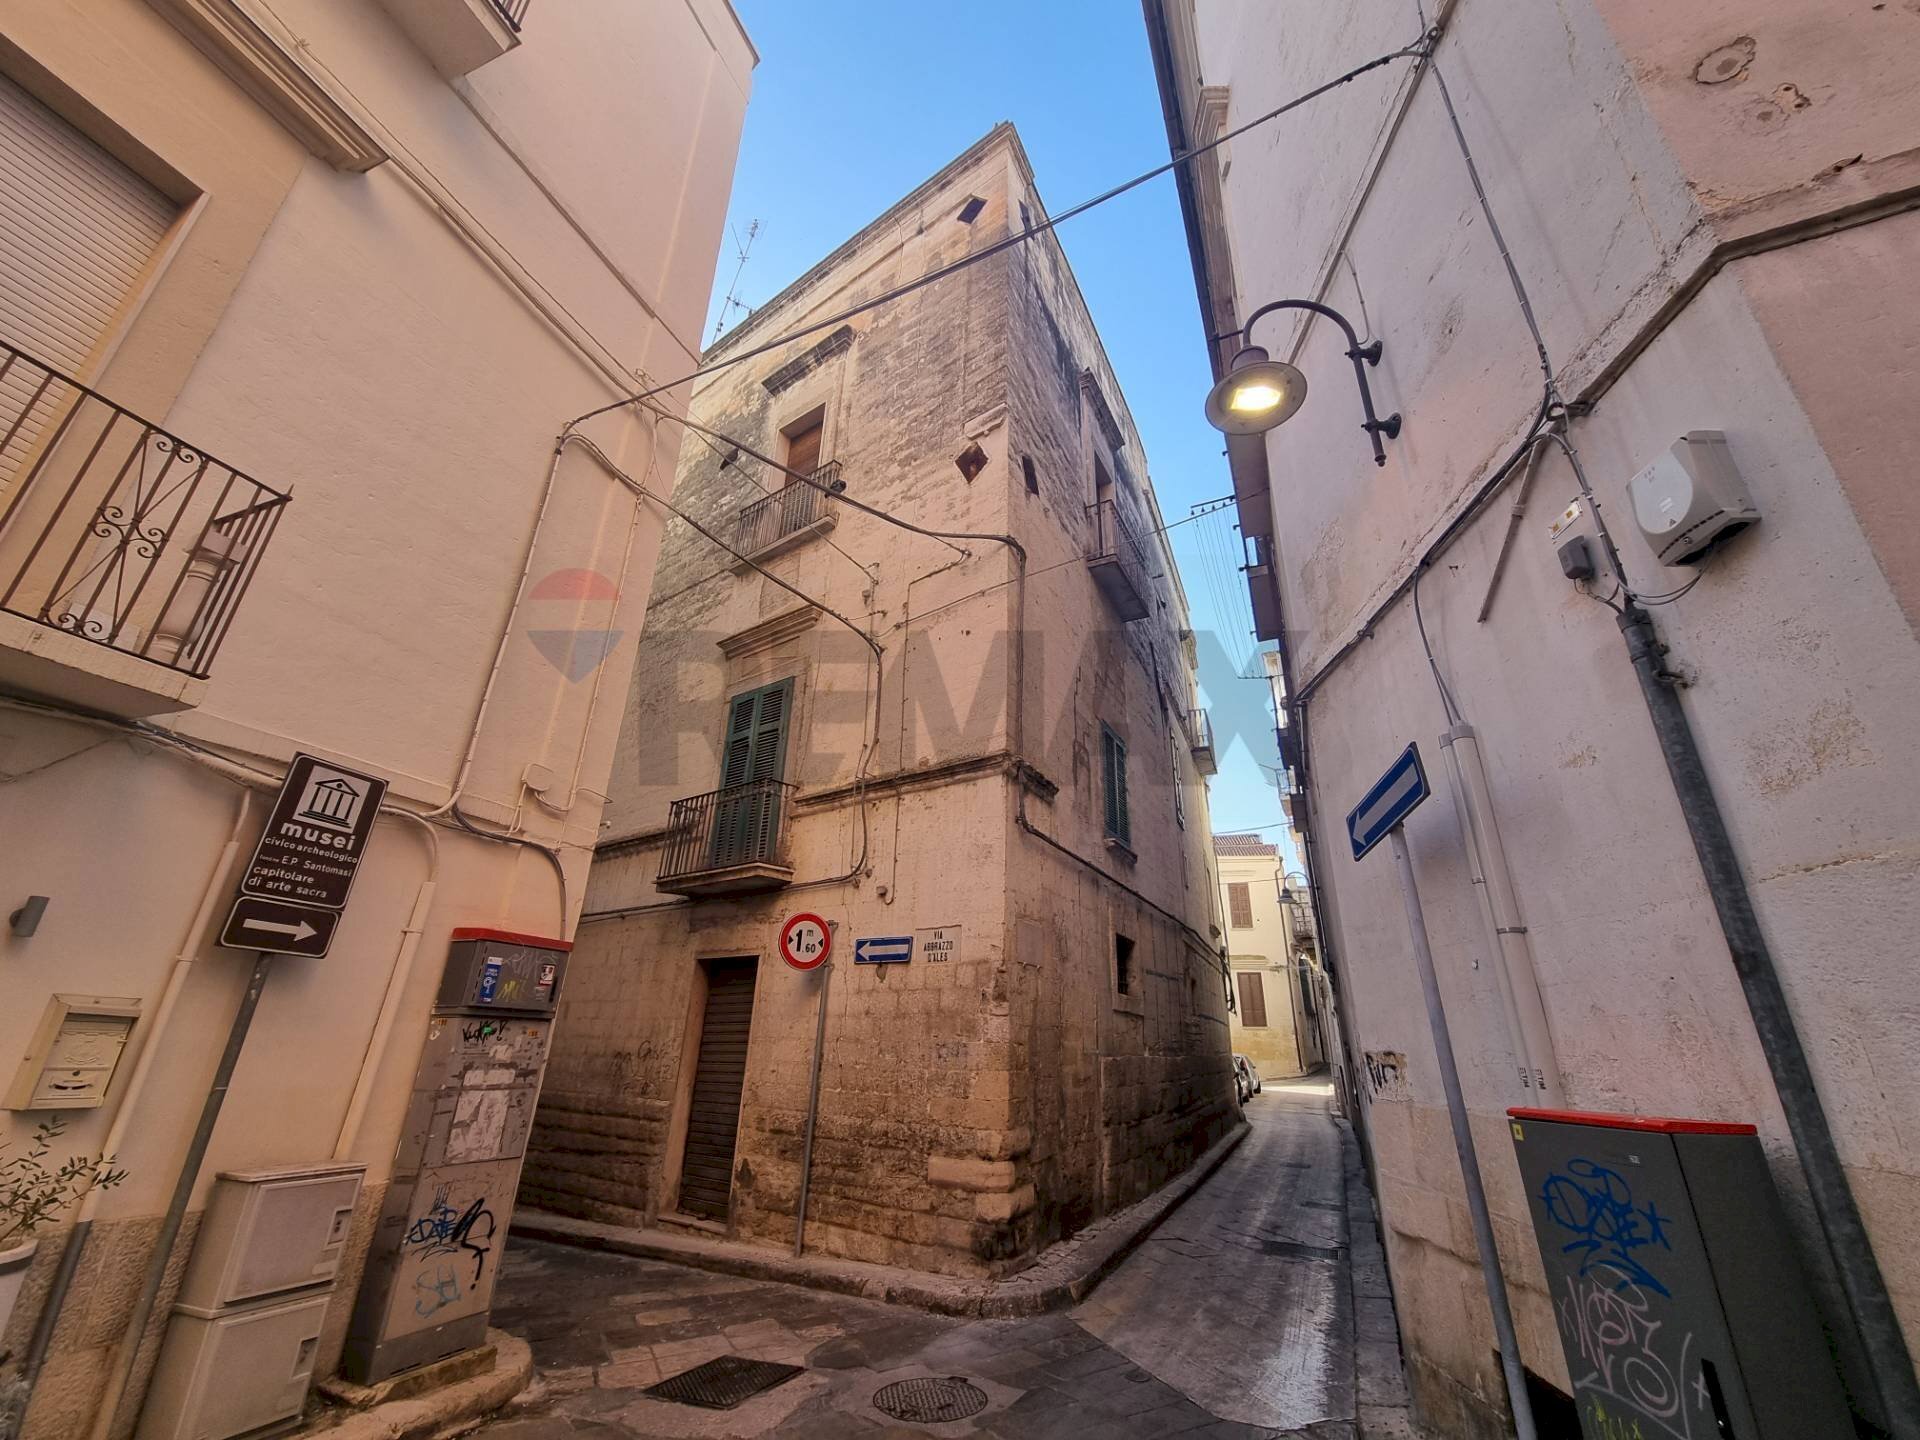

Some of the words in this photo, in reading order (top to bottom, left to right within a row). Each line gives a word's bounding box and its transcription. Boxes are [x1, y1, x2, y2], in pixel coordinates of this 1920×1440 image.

[280, 822, 356, 851] musei
[264, 836, 296, 849] civico
[297, 844, 358, 864] archeologico
[253, 866, 315, 884] capitolare
[303, 860, 353, 877] Santomasi
[248, 876, 262, 887] di
[265, 880, 292, 892] arte
[295, 886, 328, 899] sacra
[933, 930, 943, 940] VIA
[923, 941, 953, 952] ABBRAZZO
[927, 952, 948, 963] D'ALES
